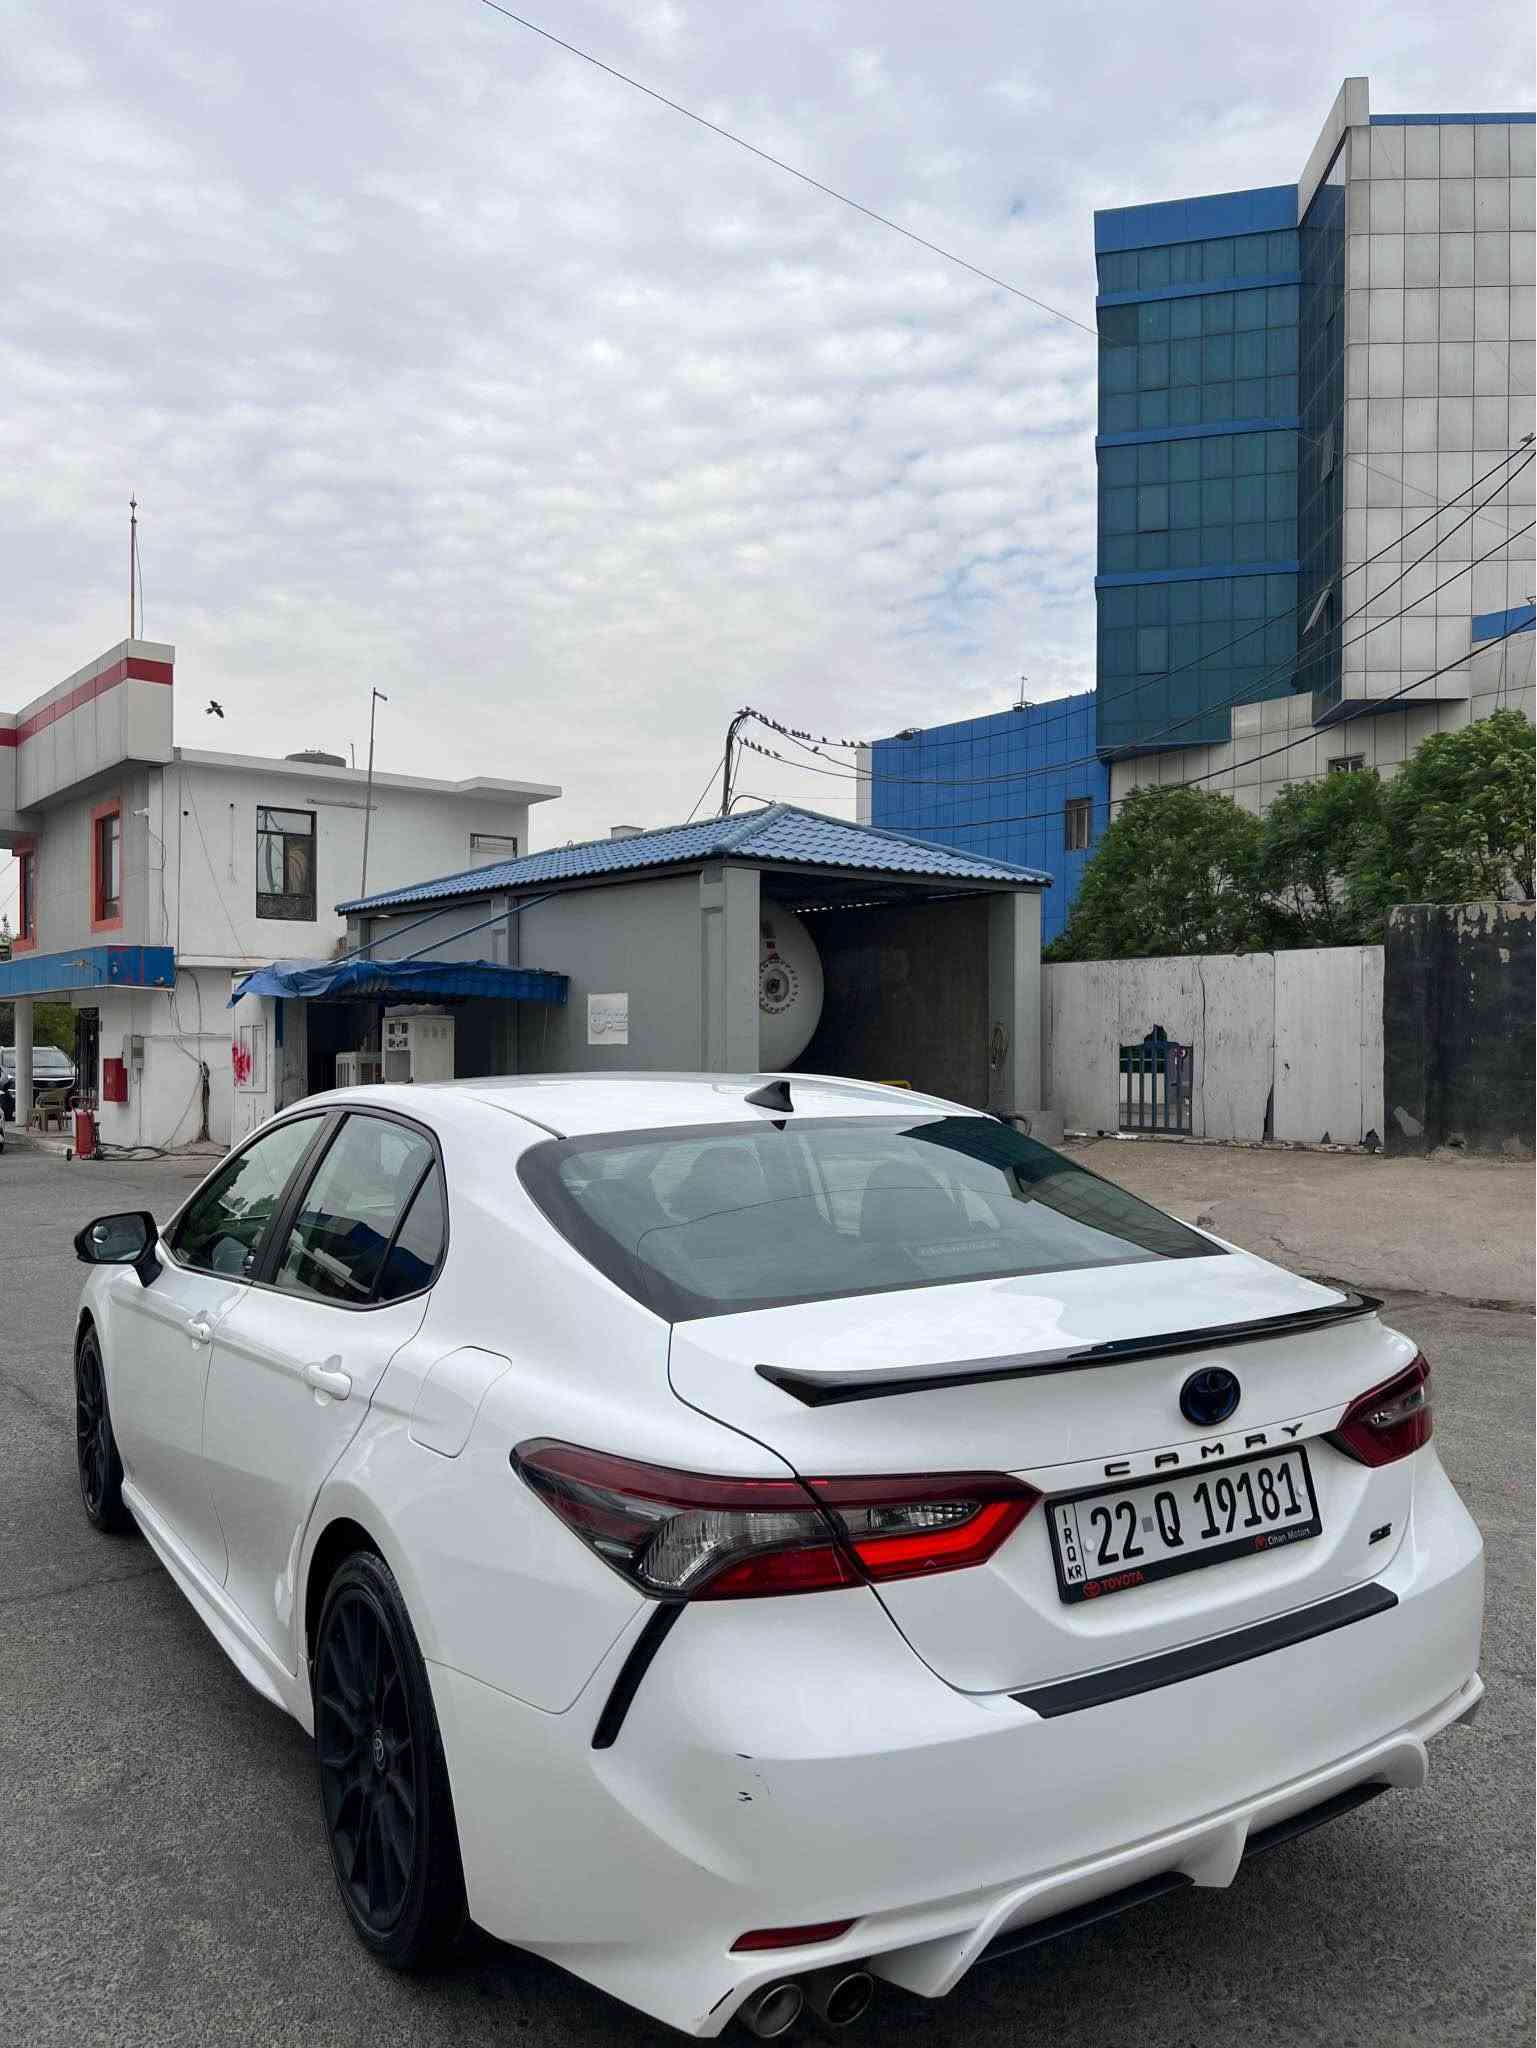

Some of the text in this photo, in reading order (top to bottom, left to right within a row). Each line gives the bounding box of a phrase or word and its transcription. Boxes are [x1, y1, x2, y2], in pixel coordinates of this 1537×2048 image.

[1104, 1423, 1303, 1477] CAMRY
[1090, 1462, 1301, 1566] 22 Q 19181
[1368, 1522, 1392, 1546] SE
[1067, 1564, 1083, 1580] KR
[1103, 1570, 1145, 1590] TOYOTA
